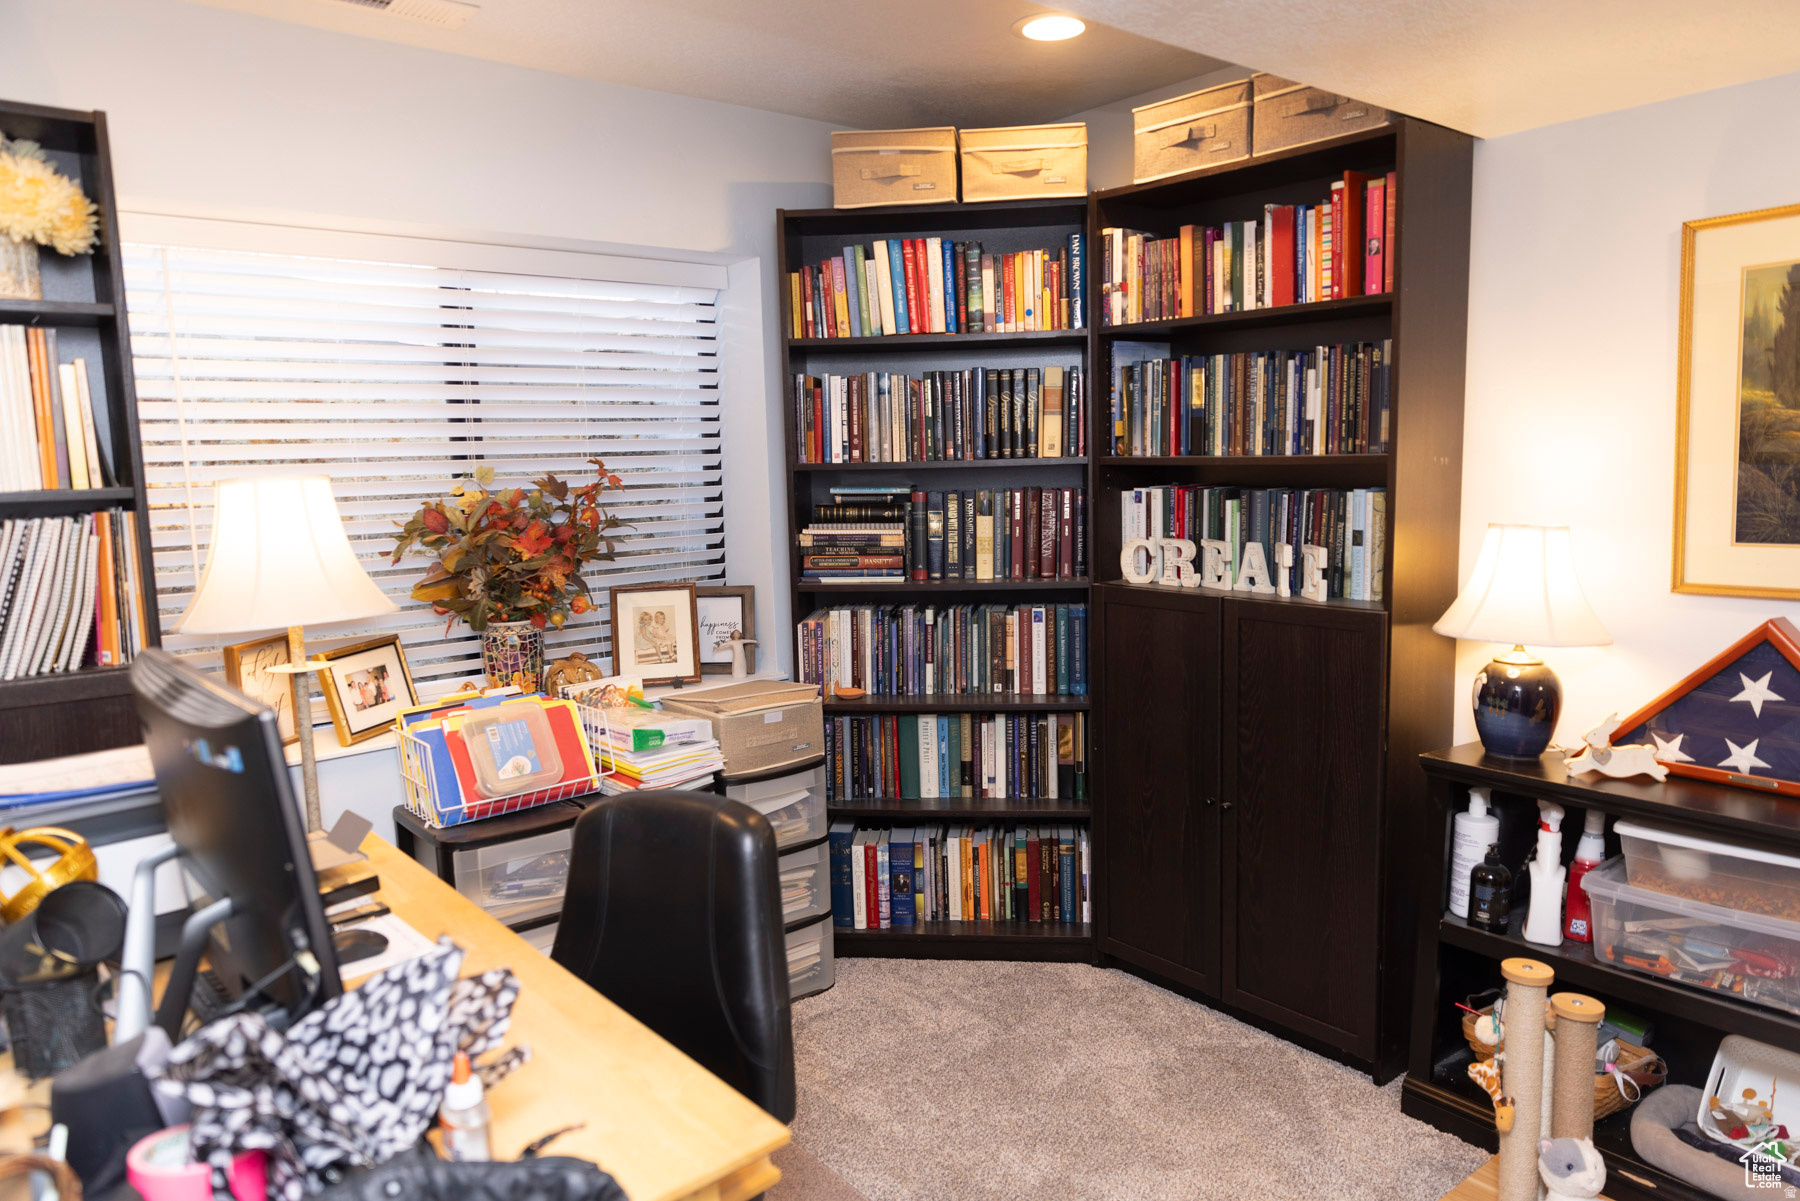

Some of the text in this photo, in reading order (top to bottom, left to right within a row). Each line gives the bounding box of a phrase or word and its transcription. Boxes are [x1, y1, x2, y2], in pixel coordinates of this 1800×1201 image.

[1072, 234, 1081, 290] DAN BROWN
[1103, 296, 1111, 313] 1776
[1041, 492, 1053, 510] EZRA
[964, 498, 974, 534] JOSEPH SMITH
[1041, 529, 1053, 558] BENSON
[1120, 536, 1328, 602] CREATE
[700, 616, 739, 635] happiness
[835, 719, 843, 784] SENTENCE SERMONS
[853, 756, 858, 764] MY
